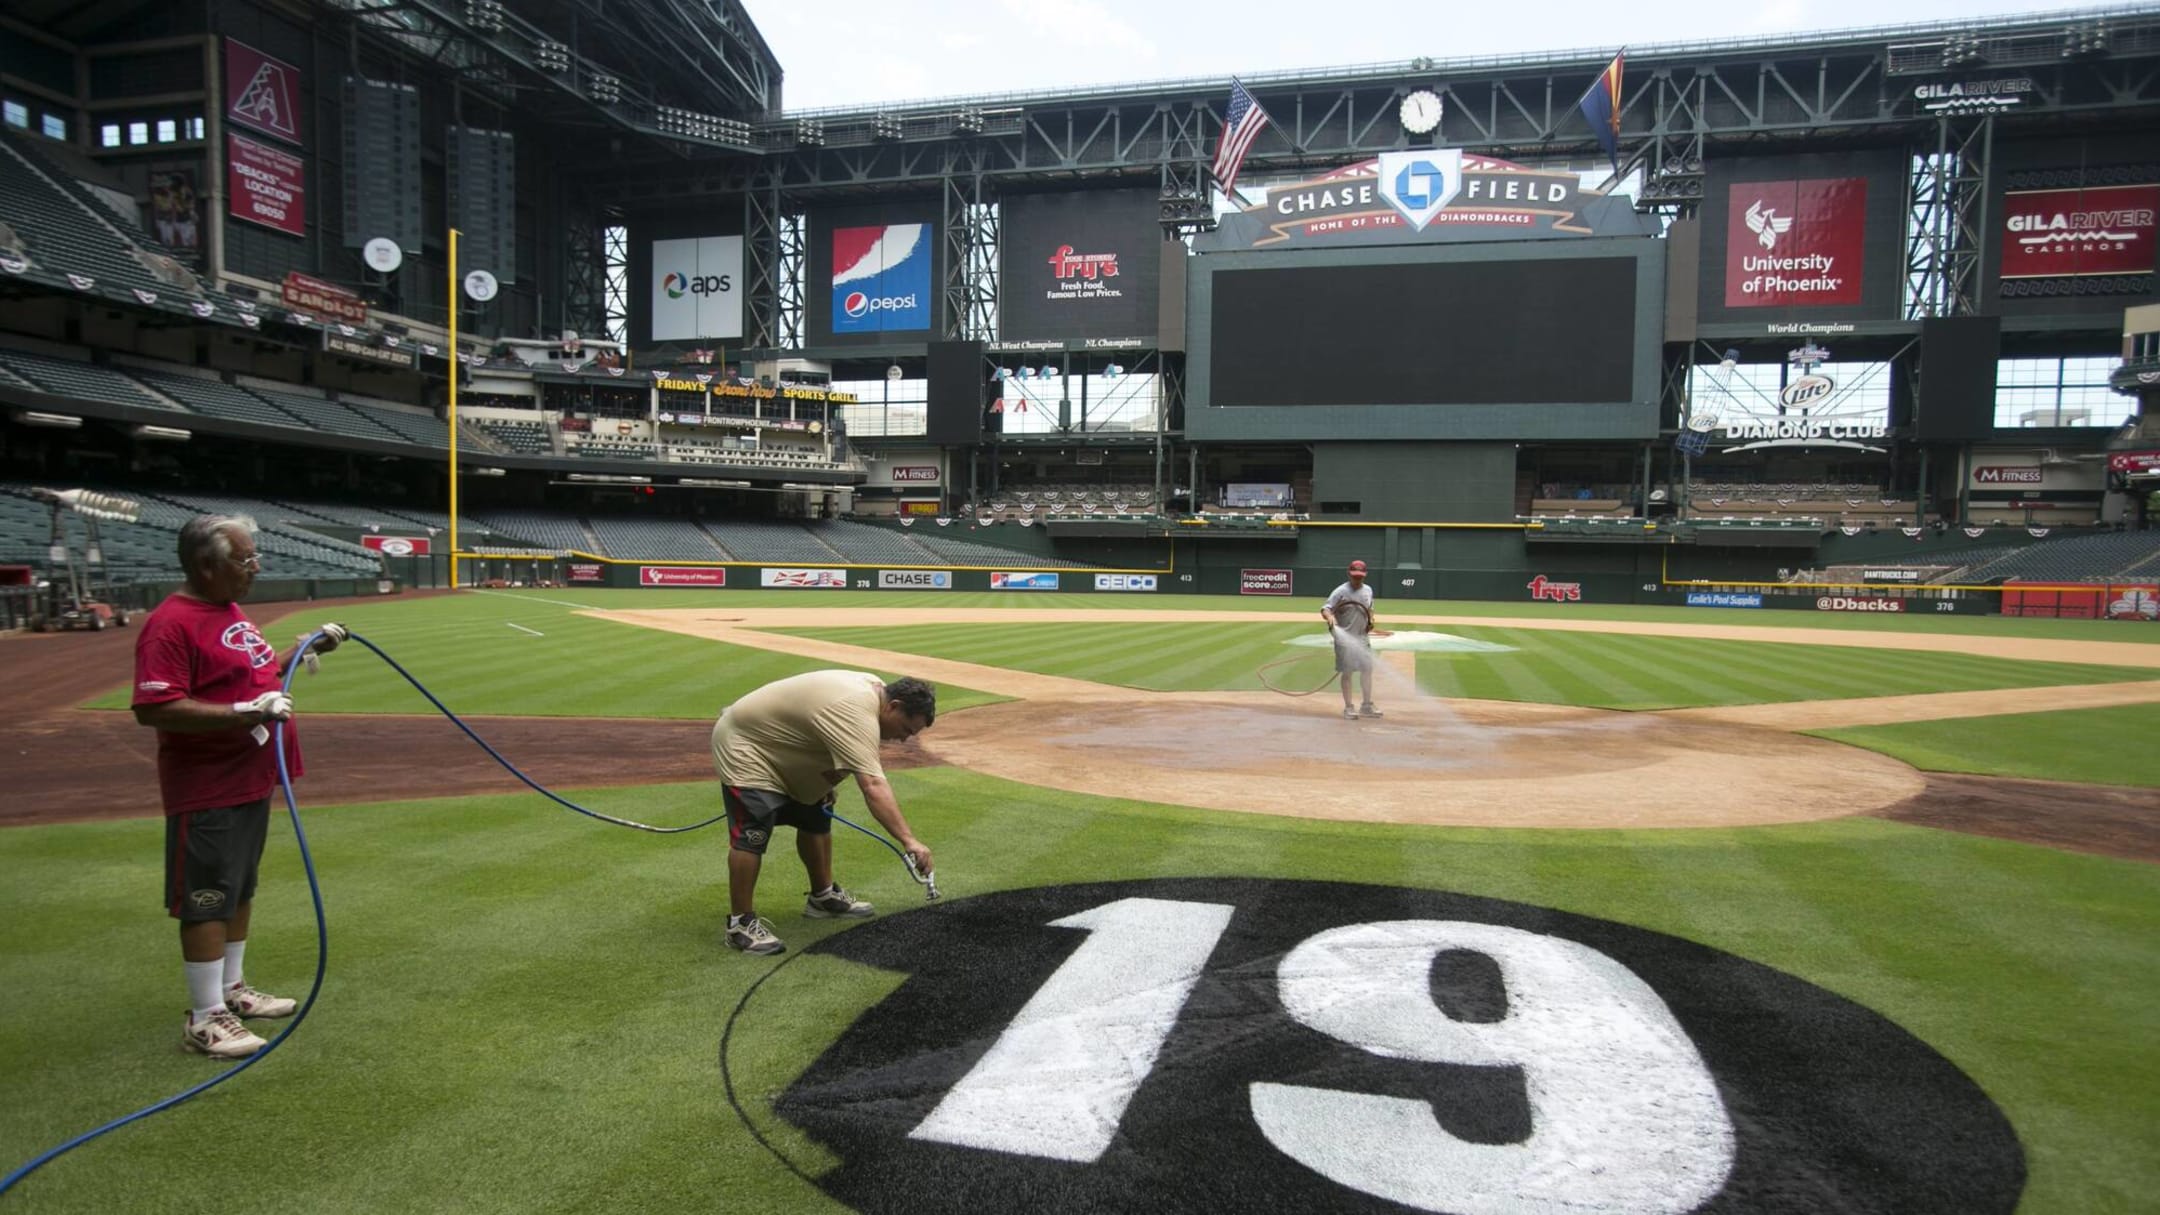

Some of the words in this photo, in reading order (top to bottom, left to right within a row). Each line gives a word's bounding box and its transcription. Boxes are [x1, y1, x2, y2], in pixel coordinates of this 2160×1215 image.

[1915, 82, 1964, 99] GILA
[1965, 78, 2032, 96] RIVER
[1935, 105, 2009, 117] CASINOS
[244, 178, 293, 203] LOCATION
[1277, 185, 1372, 214] CHASE
[1468, 180, 1567, 203] FIELD
[1310, 220, 1344, 232] HOME
[1351, 217, 1366, 227] OF
[1375, 215, 1397, 225] THE
[1440, 213, 1530, 224] DIAMONDBACKS
[2007, 212, 2069, 232] GILA
[2069, 209, 2154, 229] RIVER
[2025, 242, 2125, 254] CASINOS
[1048, 244, 1119, 280] fry's
[1742, 253, 1834, 273] University
[690, 274, 731, 298] aps
[1061, 281, 1082, 291] Fresh
[1083, 280, 1105, 290] Food.
[1742, 276, 1763, 293] of
[1047, 291, 1077, 299] Famous
[1077, 289, 1095, 298] Low
[1096, 288, 1122, 297] Prices.
[286, 288, 365, 318] SANDLOT
[870, 293, 918, 313] pepsi
[1767, 323, 1798, 333] World
[1799, 323, 1855, 334] Champions
[989, 341, 1000, 350] NL
[1001, 341, 1021, 350] West
[1021, 340, 1064, 351] Champions
[1085, 338, 1096, 348] NL
[1098, 338, 1142, 348] Champions
[656, 379, 707, 392] FRIDAYS
[783, 388, 826, 400] SPORTS
[828, 392, 858, 403] GRILL
[1790, 383, 1827, 406] Lite
[1726, 424, 1822, 439] DIAMOND
[1829, 424, 1886, 439] CLUB
[909, 471, 936, 479] FITNESS
[1981, 469, 1999, 481] M
[2001, 472, 2041, 481] FITNESS
[885, 573, 932, 584] CHASE
[1097, 575, 1156, 588] GEICO
[1180, 574, 1193, 582] 413
[1243, 572, 1288, 582] freecredit
[1401, 578, 1415, 587] 407
[1243, 581, 1289, 590] score.com
[1642, 583, 1657, 592] 413
[1712, 594, 1729, 604] Pool
[1729, 595, 1760, 607] Supplies
[1817, 597, 1899, 612] @Dbacks
[1936, 602, 1954, 611] 376
[906, 895, 1737, 1215] 19
